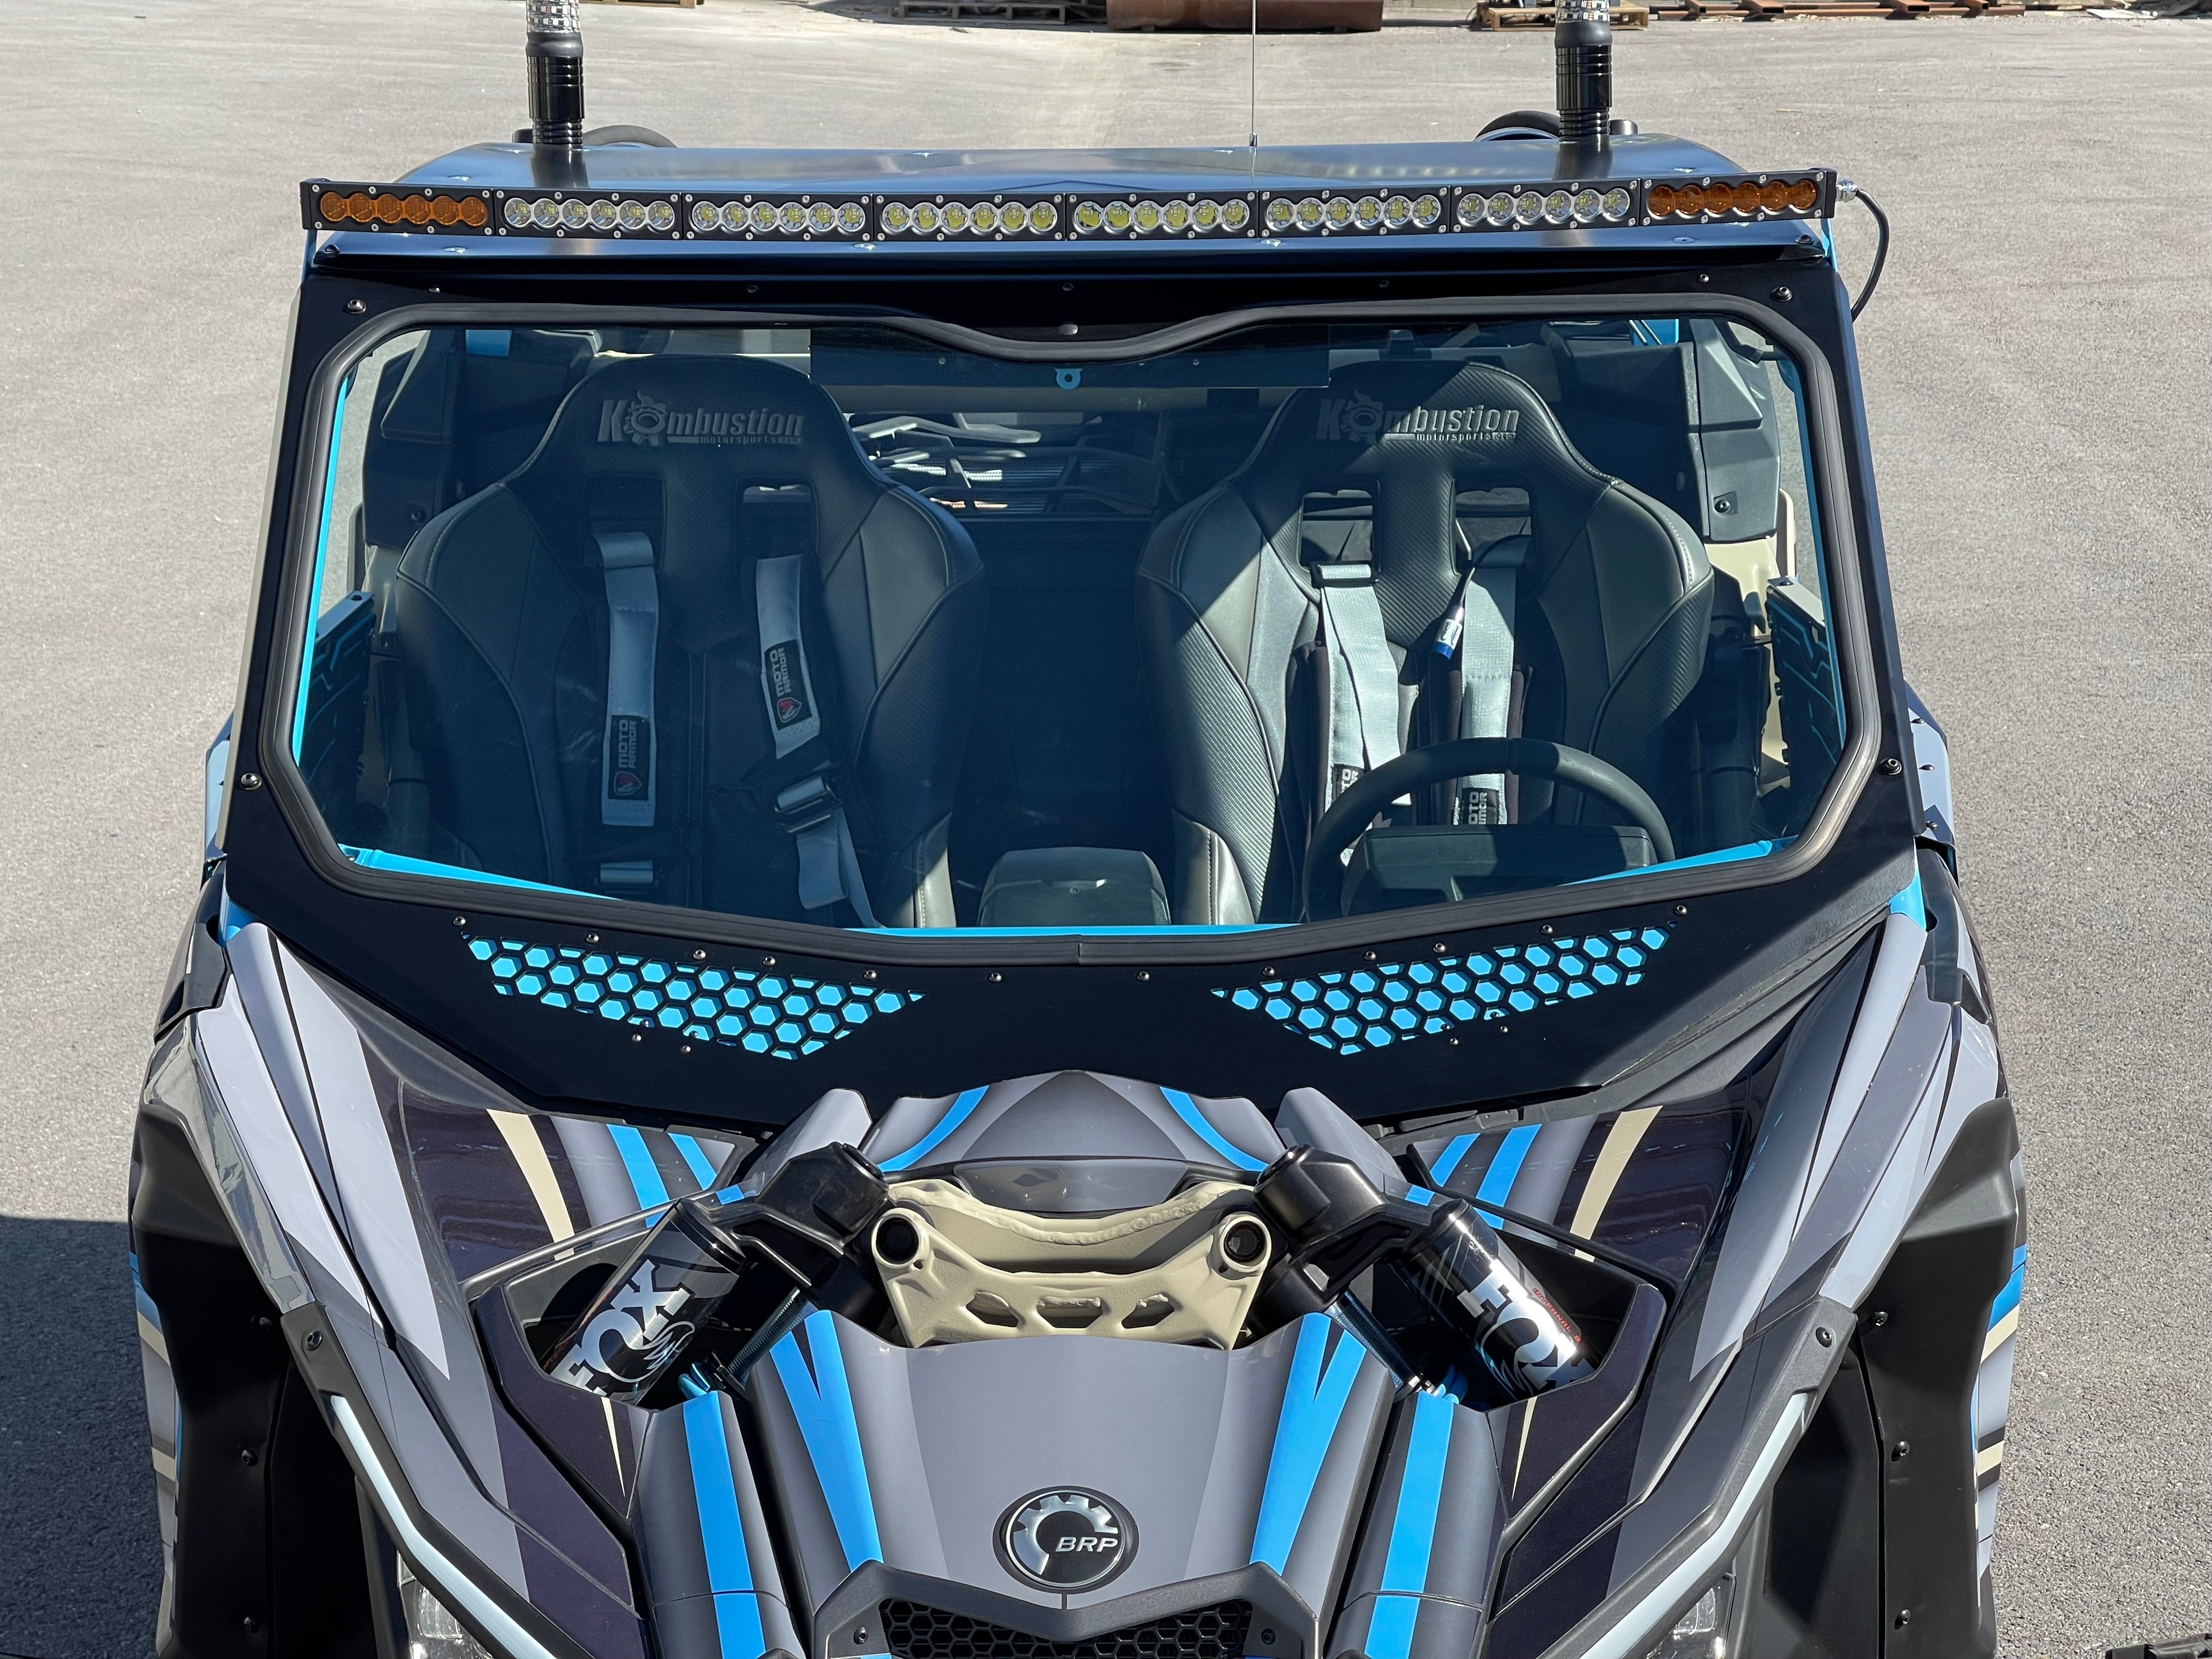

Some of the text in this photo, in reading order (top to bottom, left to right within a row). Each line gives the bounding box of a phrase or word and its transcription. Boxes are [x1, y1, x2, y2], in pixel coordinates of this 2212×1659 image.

[597, 395, 805, 443] Kombustion
[1317, 395, 1520, 441] Kombustion
[770, 650, 785, 697] MOTO
[777, 647, 792, 693] ARMOR
[618, 719, 629, 768] MOTO
[628, 720, 637, 769] ARMOR
[1468, 791, 1479, 824] OTO
[1478, 792, 1487, 824] MOR
[550, 1259, 691, 1397] FOX
[1457, 1259, 1595, 1390] FOX
[1532, 1288, 1572, 1333] INTERNAL
[1055, 1537, 1119, 1552] BRP
